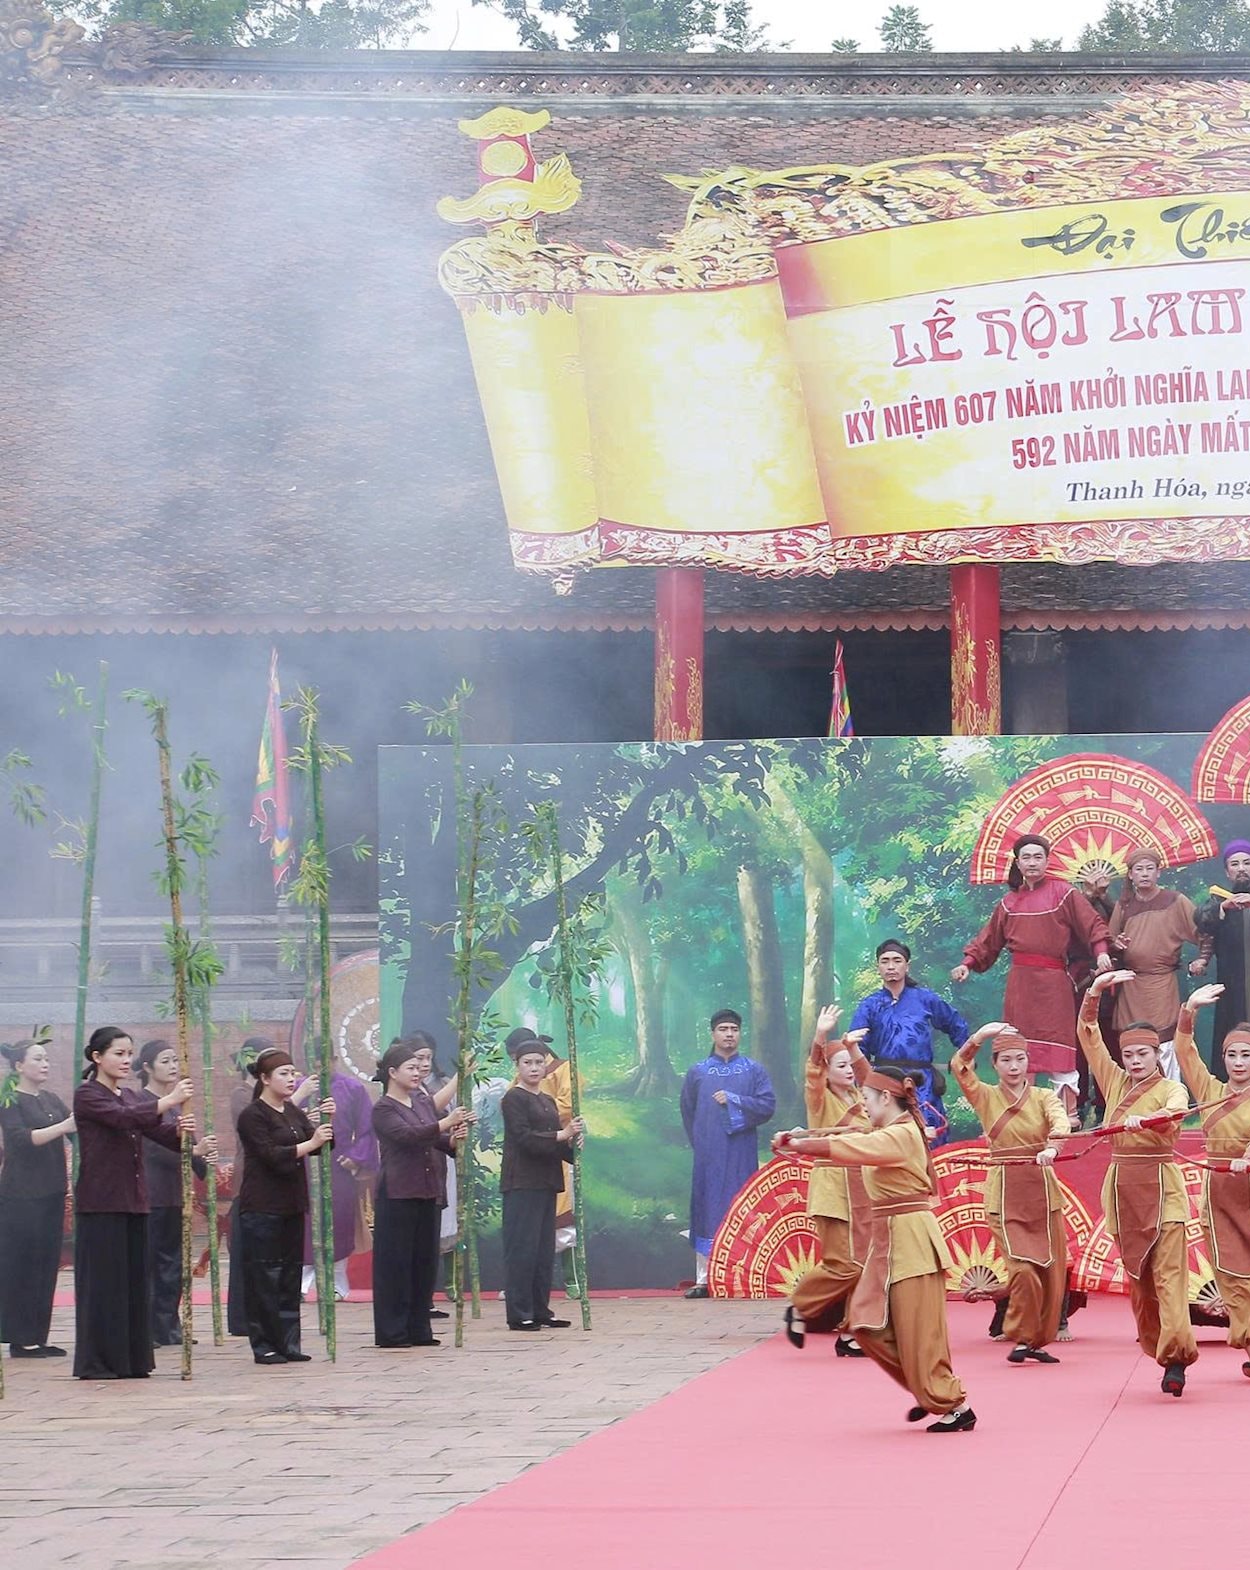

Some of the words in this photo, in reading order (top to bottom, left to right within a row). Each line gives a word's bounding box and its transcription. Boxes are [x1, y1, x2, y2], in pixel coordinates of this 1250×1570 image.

[1021, 212, 1135, 260] Đại
[889, 298, 963, 368] LỄ
[976, 291, 1088, 361] HỘI
[1110, 287, 1246, 342] LAM
[844, 400, 875, 445] KỶ
[883, 397, 948, 441] NIỆM
[954, 391, 997, 427] 607
[1007, 379, 1063, 419] NĂM
[1070, 367, 1127, 412] KHỞI
[1135, 365, 1208, 406] NGHĨA
[1012, 438, 1057, 470] 592
[1064, 424, 1119, 465] NĂM
[1128, 417, 1192, 459] NGÀY
[1067, 481, 1145, 502] Thanh
[1154, 476, 1207, 499] Hóa,
